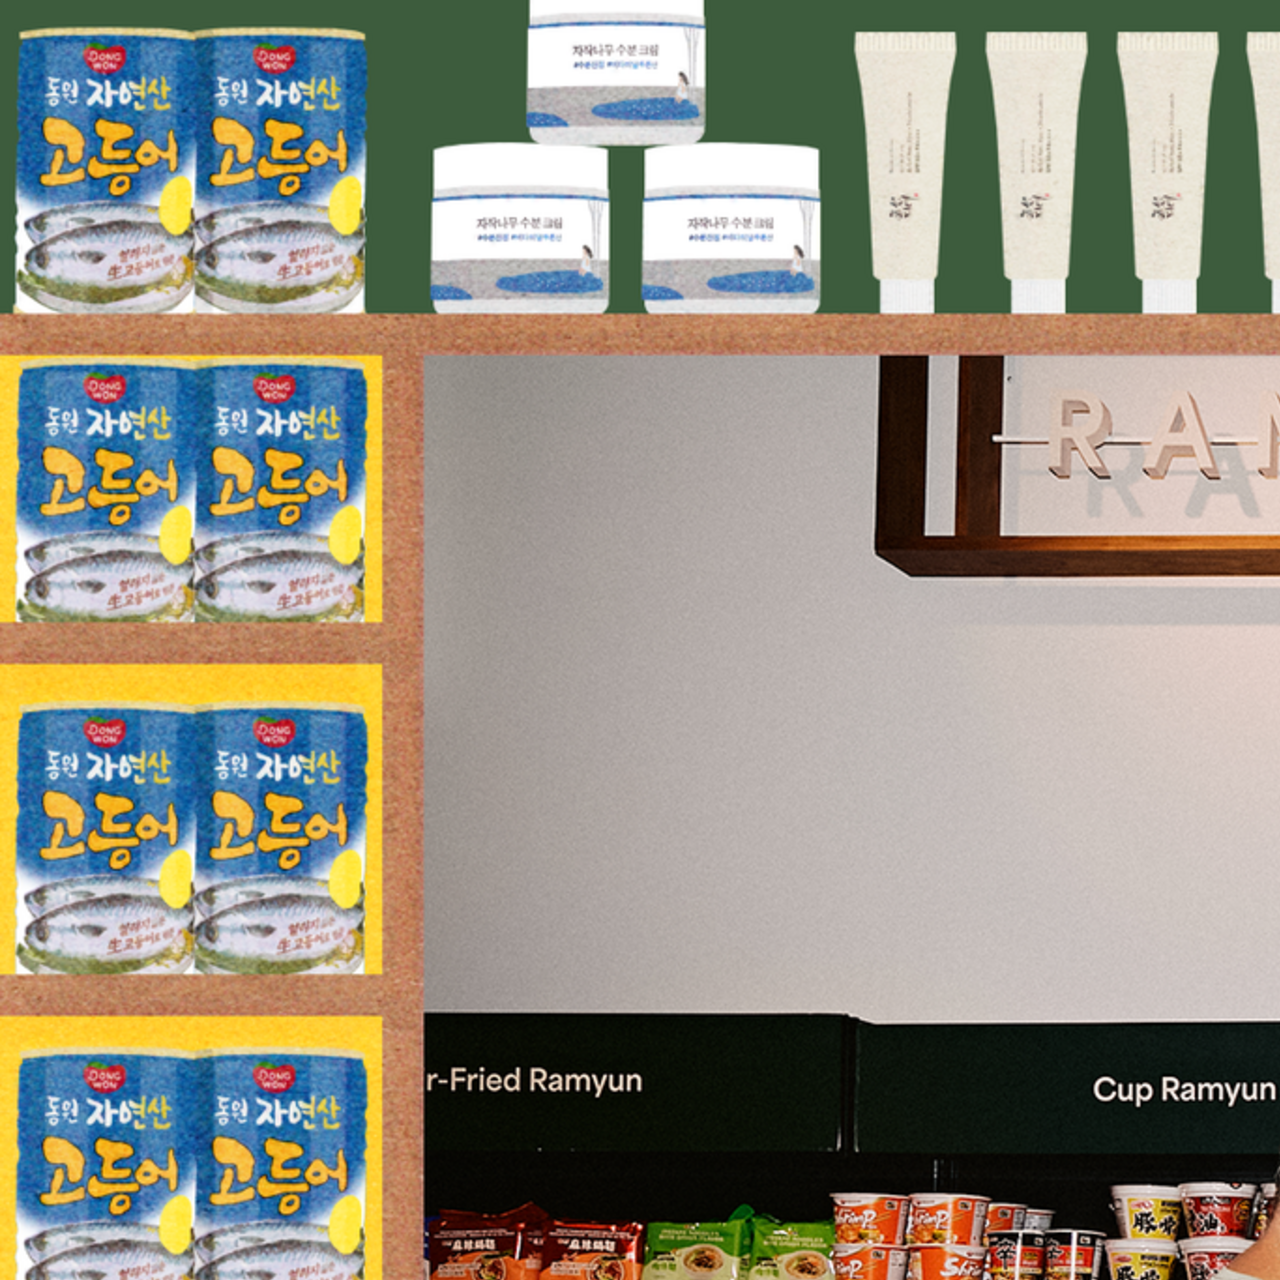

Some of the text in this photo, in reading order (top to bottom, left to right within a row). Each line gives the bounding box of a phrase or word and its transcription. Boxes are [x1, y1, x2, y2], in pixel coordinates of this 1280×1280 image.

[88, 50, 122, 61] DONG
[93, 61, 117, 70] WON
[258, 50, 292, 61] DONG
[263, 61, 287, 70] WON
[46, 76, 172, 110] 동원 자연산
[216, 76, 342, 110] 동원 자연산
[40, 117, 178, 196] 고등어
[210, 117, 348, 196] 고등어
[88, 380, 122, 391] DONG
[93, 391, 117, 400] WON
[258, 380, 292, 391] DONG
[263, 391, 287, 400] WON
[46, 406, 172, 440] 동원 자연산
[216, 406, 342, 440] 동원 자연산
[40, 447, 178, 526] 고등어
[210, 447, 348, 526] 고등어
[88, 724, 122, 735] DONG
[93, 735, 117, 744] WON
[258, 724, 292, 735] DONG
[263, 735, 287, 744] WON
[46, 750, 172, 784] 동원 자연산
[216, 750, 342, 784] 동원 자연산
[40, 791, 178, 870] 고등어
[210, 791, 348, 870] 고등어
[88, 1070, 122, 1081] DONG
[93, 1081, 117, 1090] WON
[258, 1070, 292, 1081] DONG
[263, 1081, 287, 1090] WON
[530, 1068, 643, 1100] Ramyun
[1092, 1076, 1278, 1108] Cup Ramyun
[46, 1096, 172, 1130] 동원 자연산
[216, 1096, 342, 1130] 동원 자연산
[40, 1137, 178, 1216] 고등어
[210, 1137, 348, 1216] 고등어
